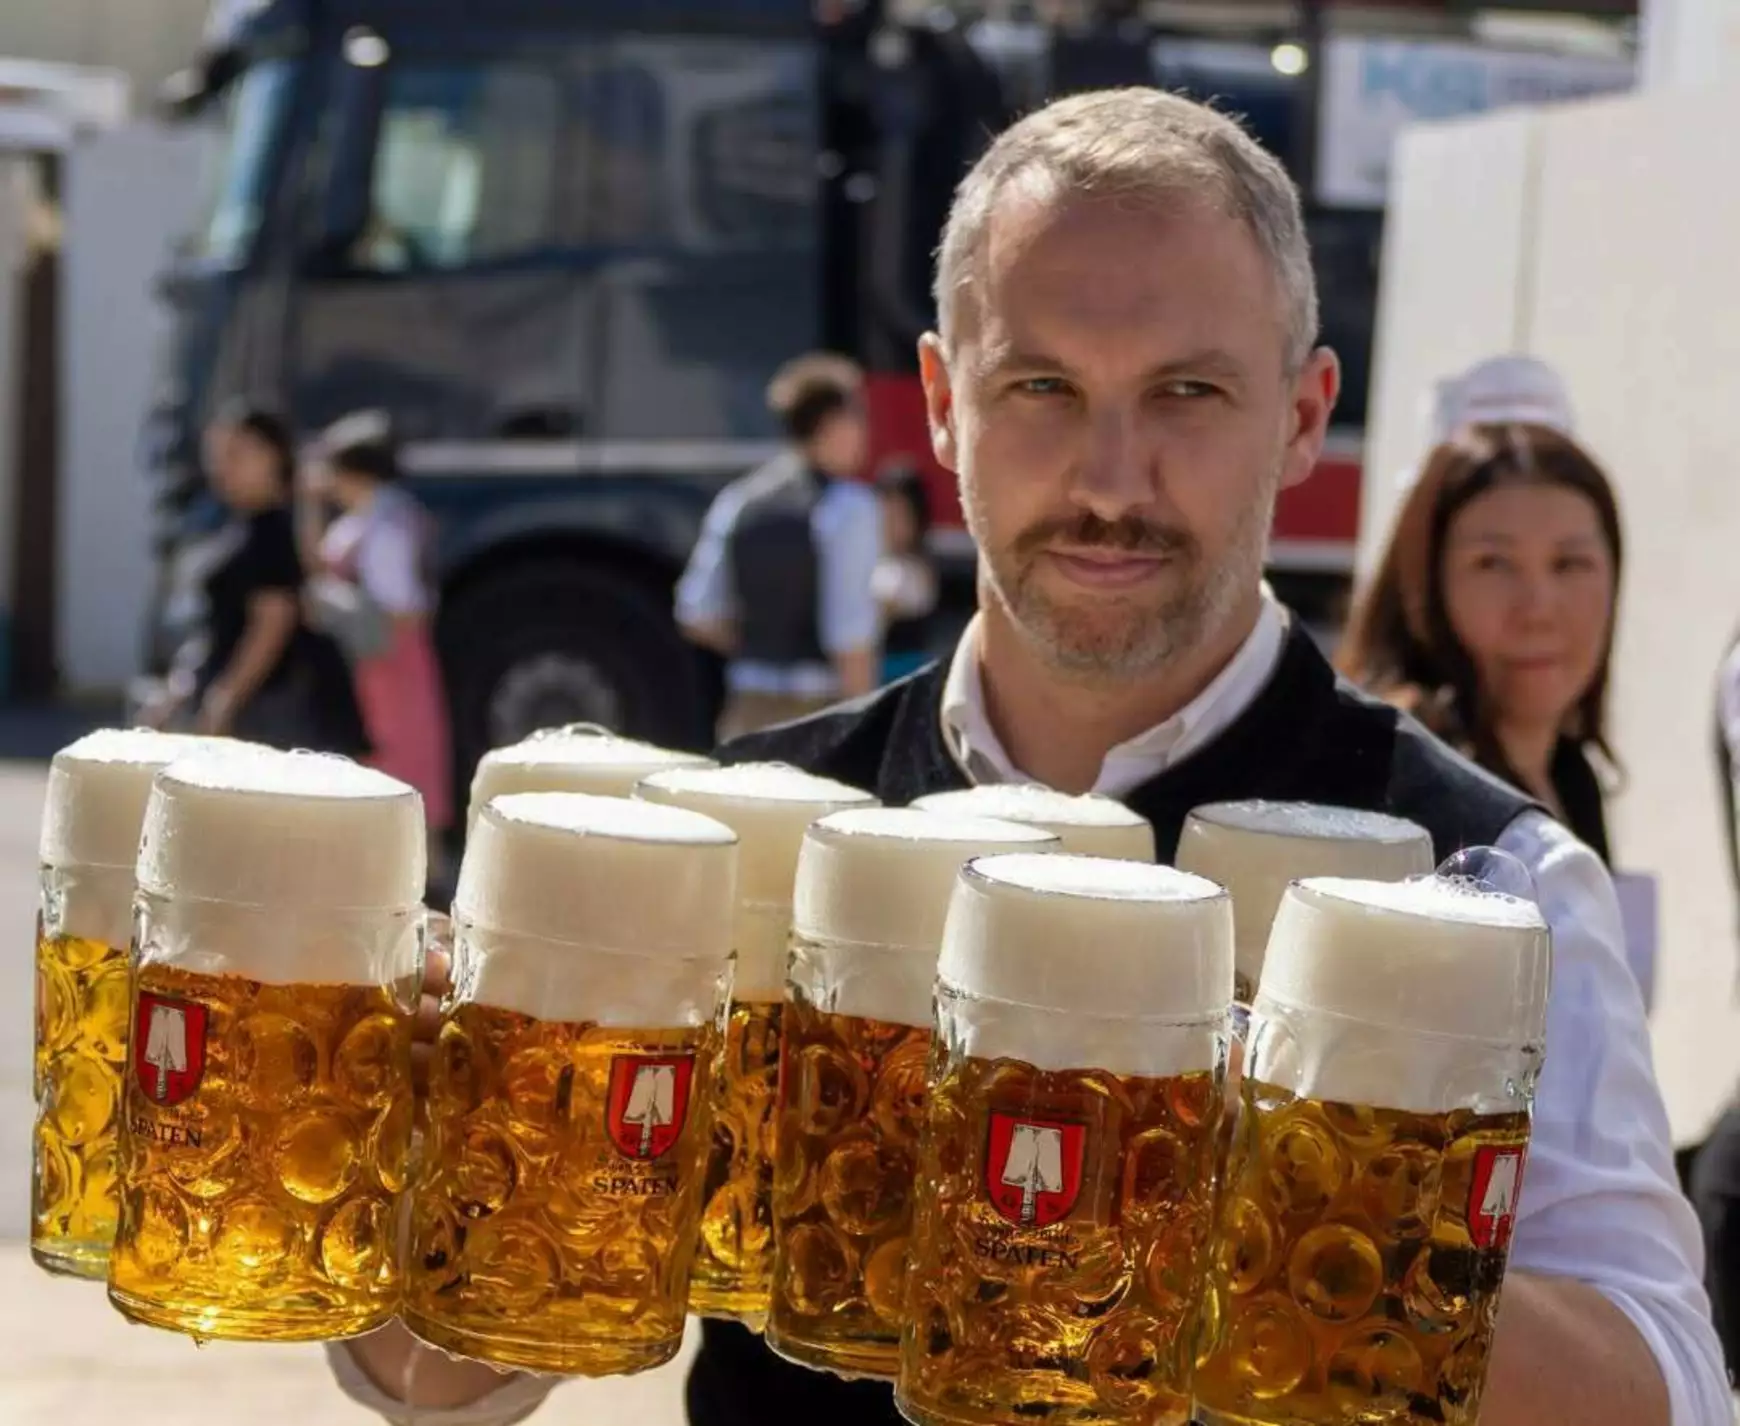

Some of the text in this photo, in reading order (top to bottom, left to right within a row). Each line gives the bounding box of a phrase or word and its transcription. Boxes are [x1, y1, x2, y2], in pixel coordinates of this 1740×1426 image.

[130, 1117, 201, 1148] SPATEN
[593, 1176, 678, 1196] SPATEN
[975, 1239, 1078, 1269] SPATEN
